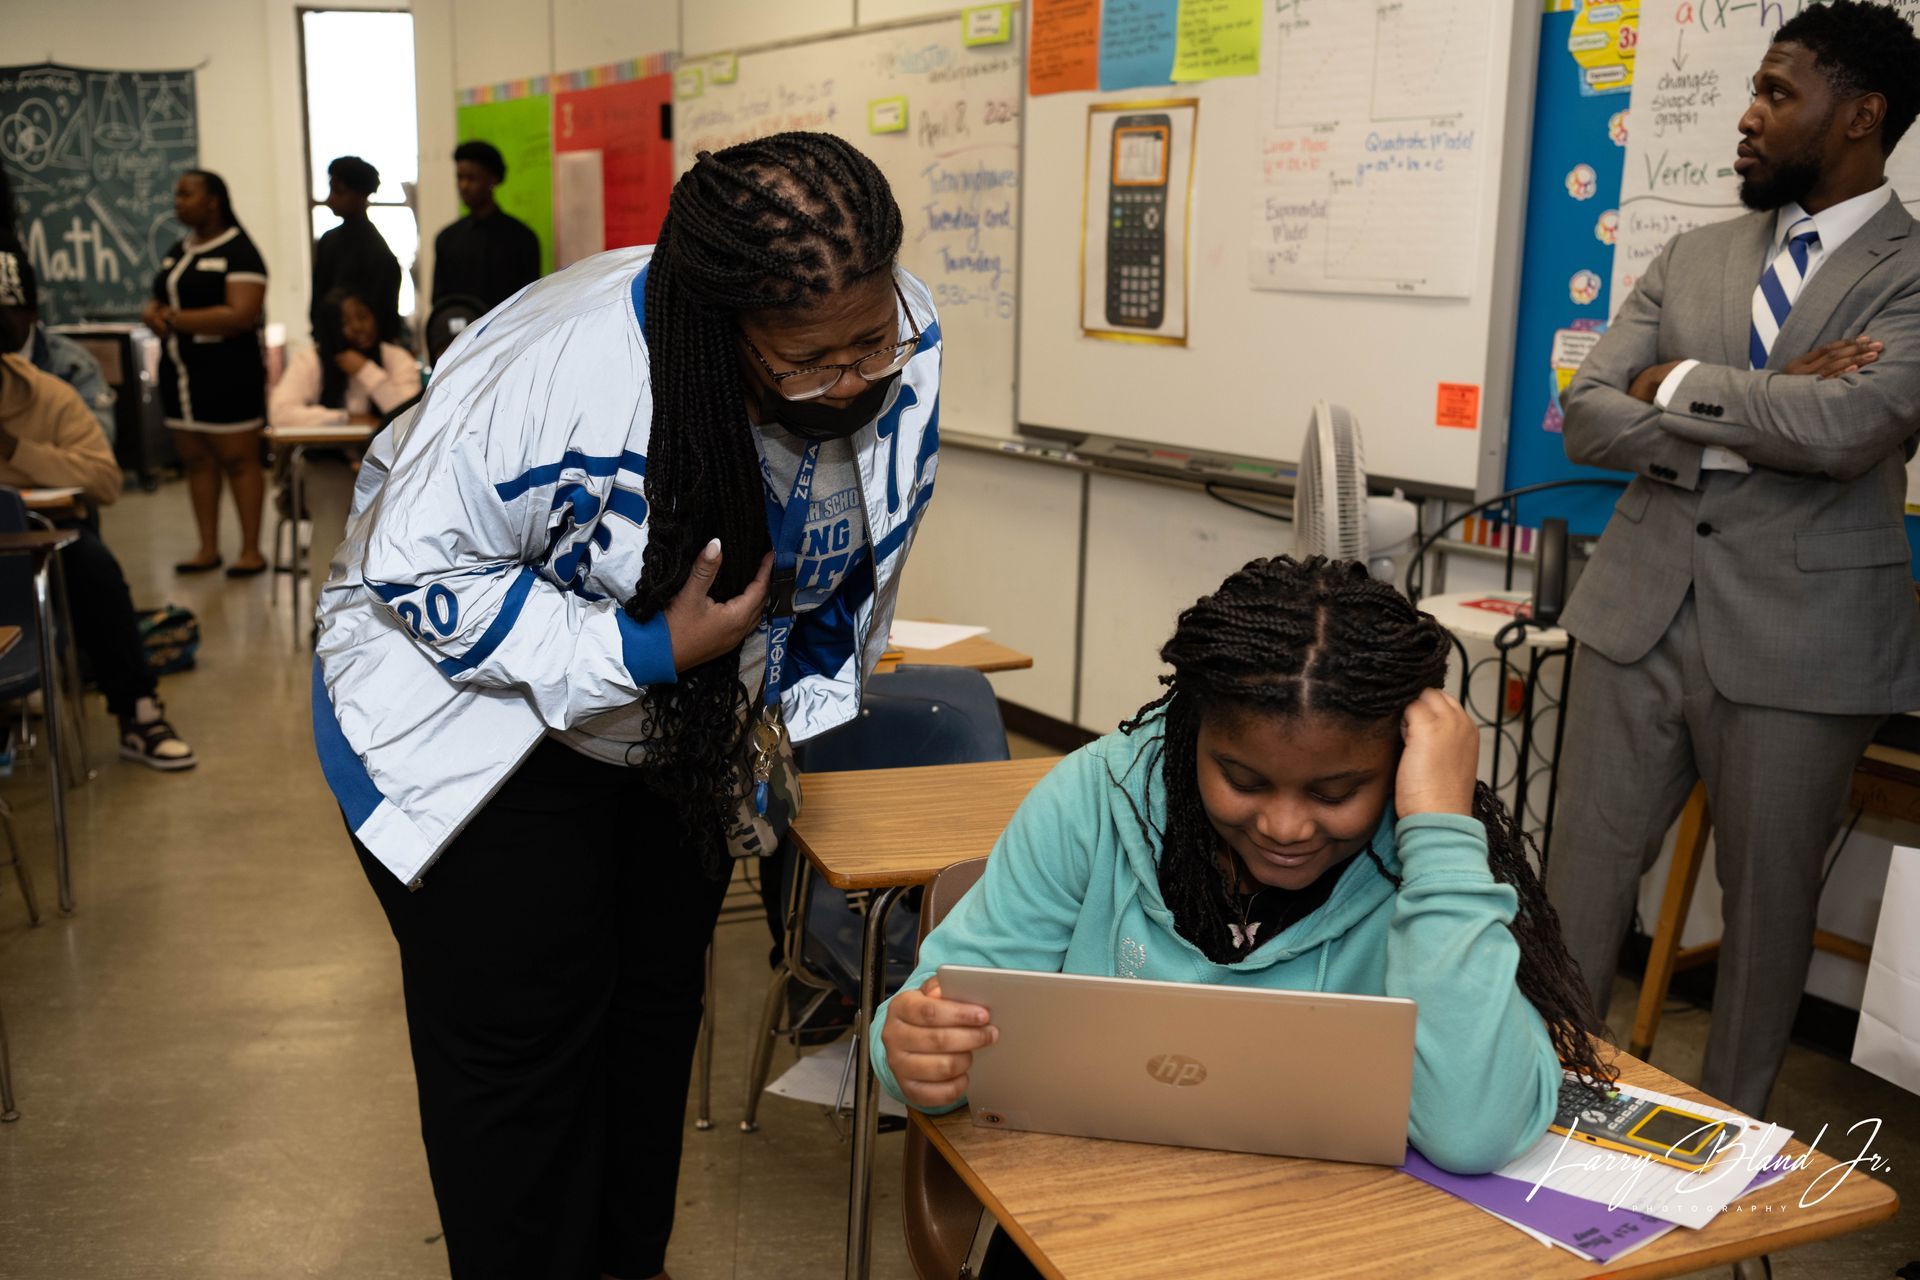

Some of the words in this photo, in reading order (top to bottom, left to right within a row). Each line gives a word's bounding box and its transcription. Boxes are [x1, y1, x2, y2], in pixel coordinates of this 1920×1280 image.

[1657, 71, 1719, 95] changes
[1700, 87, 1722, 107] of
[1654, 112, 1699, 138] graph
[1644, 149, 1709, 190] Vertex
[17, 216, 121, 283] Math
[794, 443, 819, 500] ZETA
[397, 582, 459, 641] 20
[1154, 1055, 1201, 1086] hp
